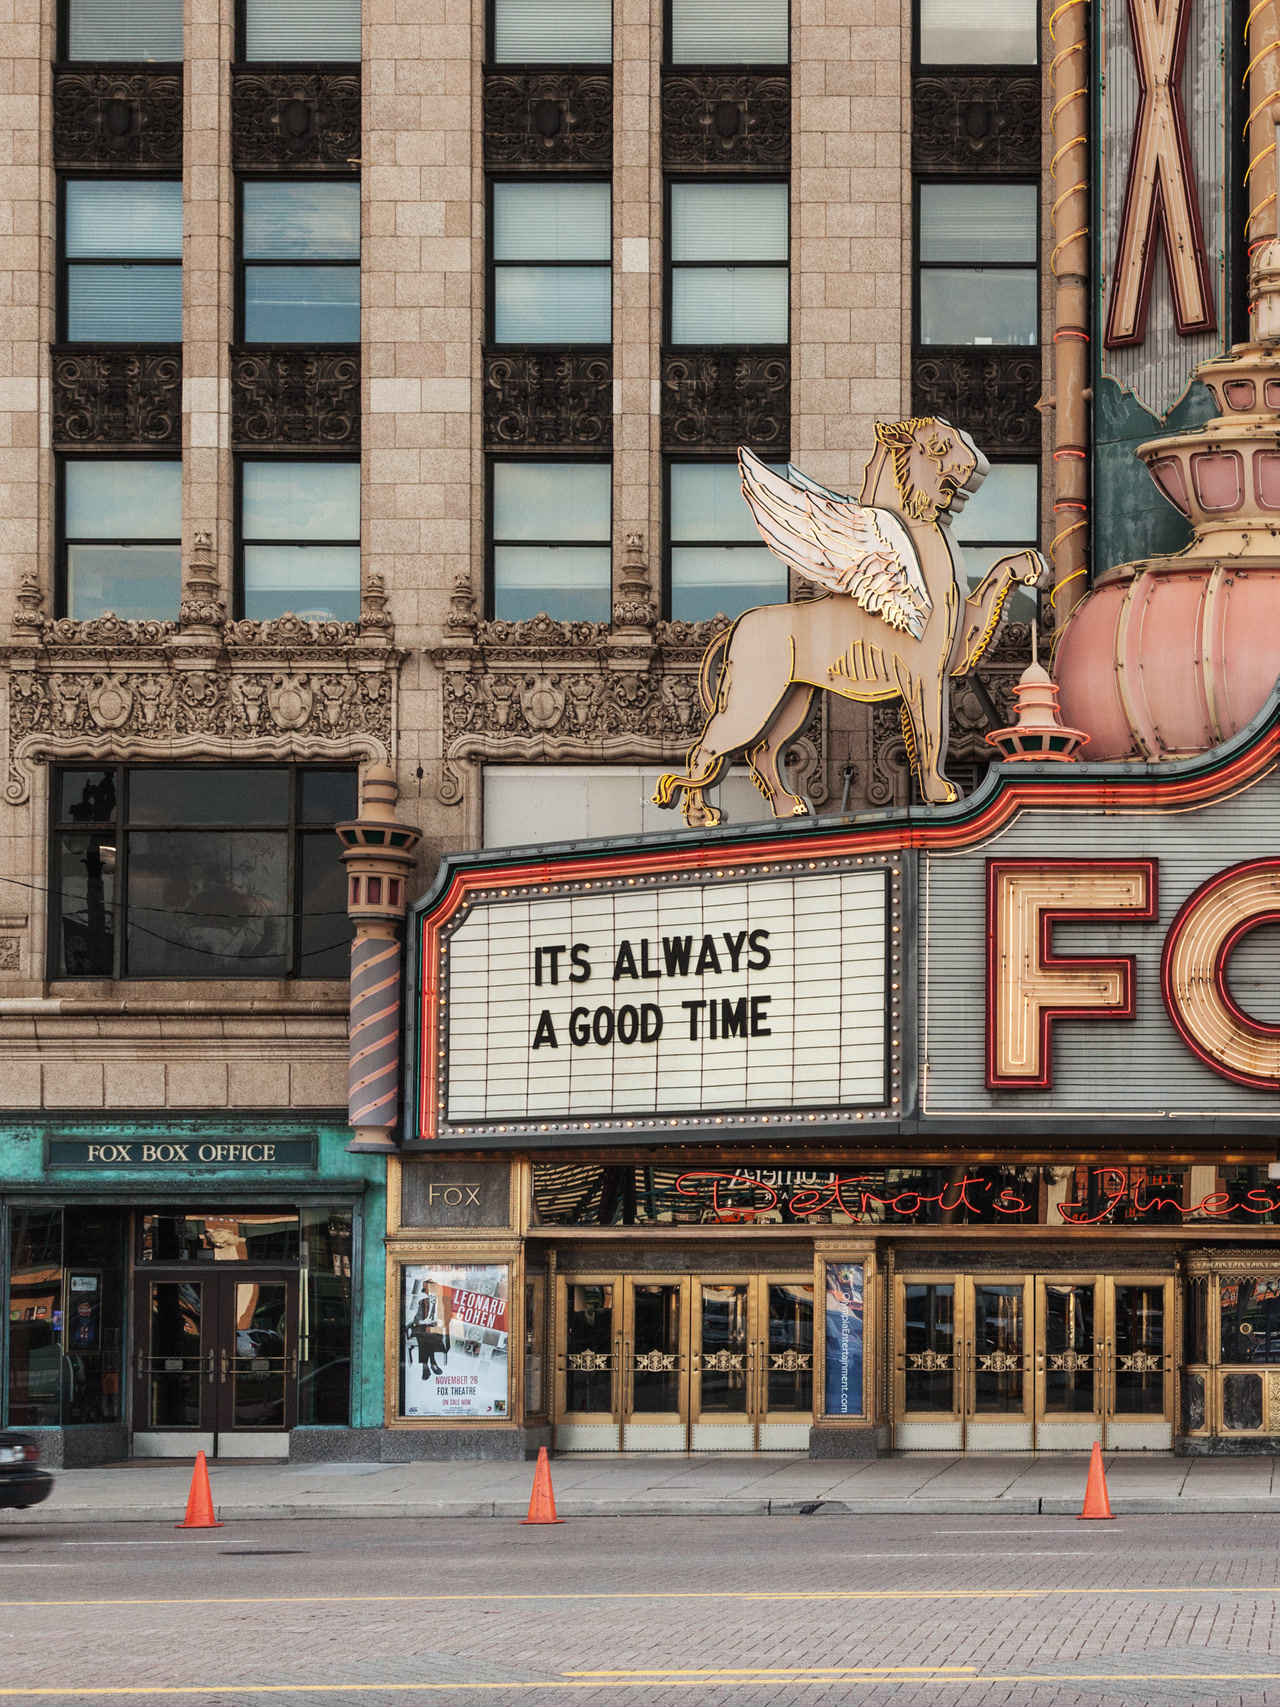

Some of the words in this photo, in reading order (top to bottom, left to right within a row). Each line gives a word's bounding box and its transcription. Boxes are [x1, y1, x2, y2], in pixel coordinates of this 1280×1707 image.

[534, 943, 592, 986] ITS
[612, 929, 772, 981] ALWAYS
[532, 1009, 559, 1049] A
[568, 1002, 664, 1047] GOOD
[681, 995, 772, 1041] TIME
[87, 1144, 133, 1162] FOX
[141, 1144, 190, 1162] BOX
[198, 1144, 276, 1162] OFFICE
[429, 1183, 481, 1206] FOX
[676, 1172, 1032, 1222] Detroit's
[453, 1289, 506, 1316] LEONARD
[456, 1306, 496, 1329] COHEN
[840, 1292, 851, 1414] OlympiaEntertainment.com
[435, 1375, 468, 1385] NOVEMBER
[470, 1375, 479, 1385] 26
[436, 1387, 449, 1396] FOX
[451, 1387, 477, 1396] THEATRE
